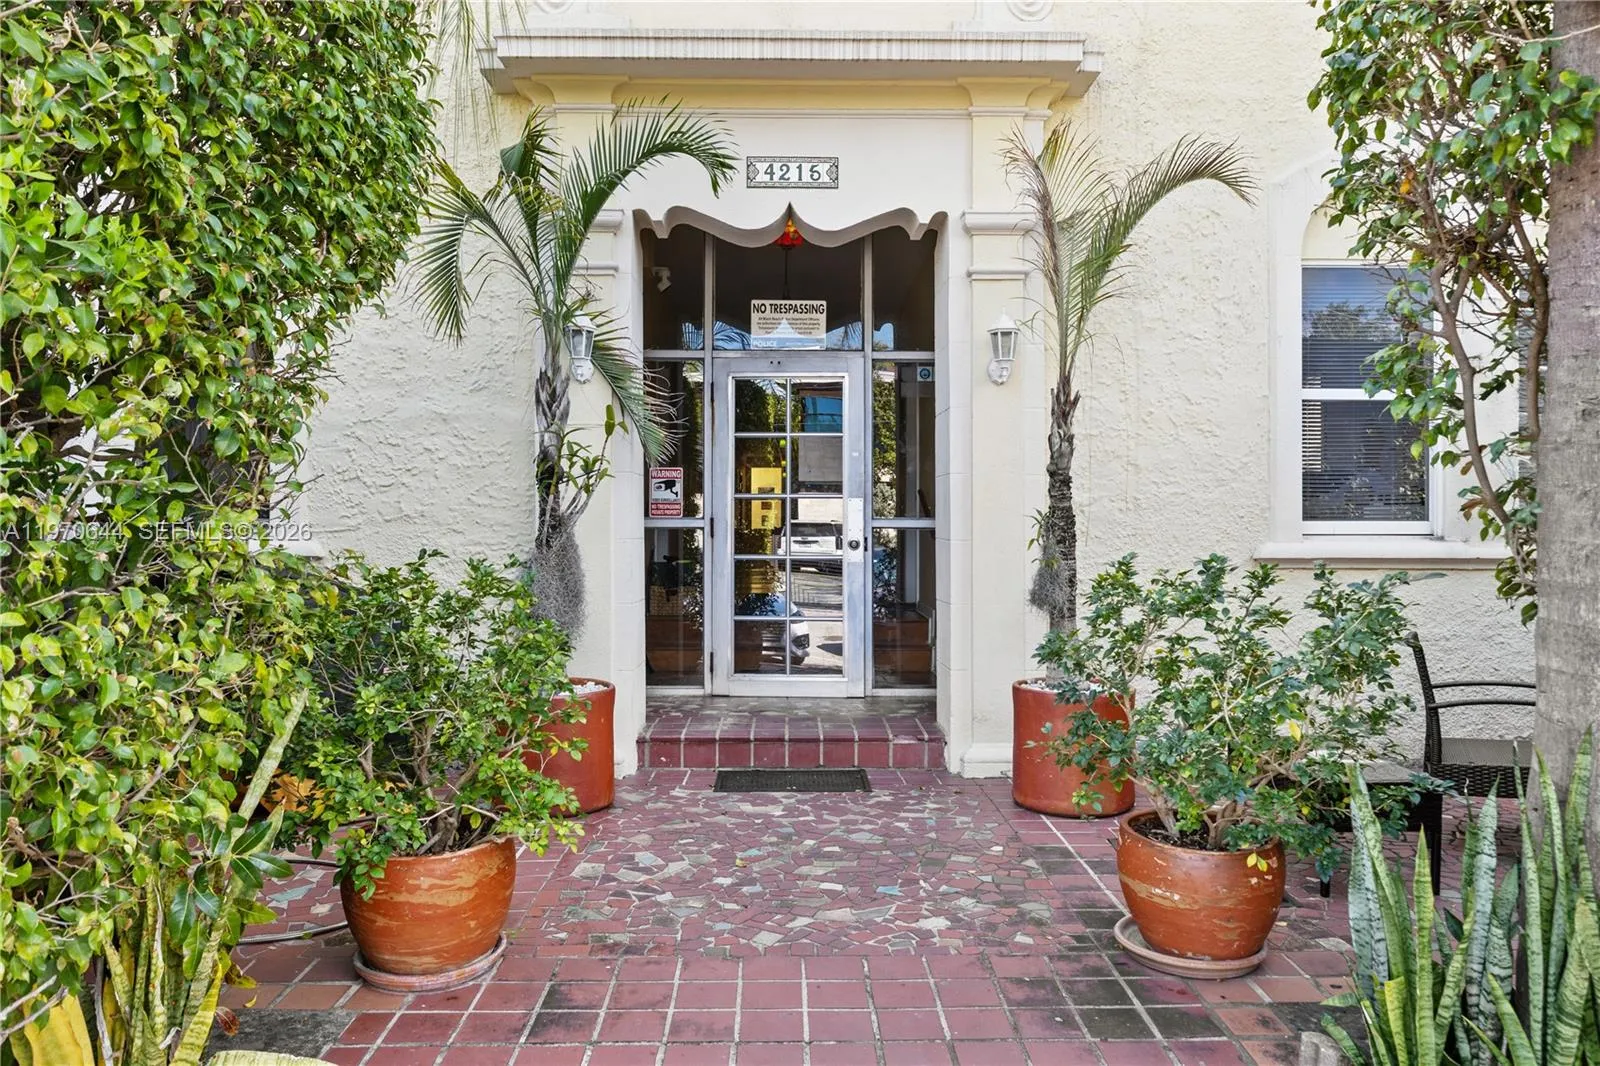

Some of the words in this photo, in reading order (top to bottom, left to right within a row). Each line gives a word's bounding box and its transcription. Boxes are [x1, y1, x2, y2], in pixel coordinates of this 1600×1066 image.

[764, 163, 821, 182] 4215
[752, 303, 767, 314] NO
[769, 303, 825, 315] TRESPASSING
[651, 470, 681, 478] WARNING
